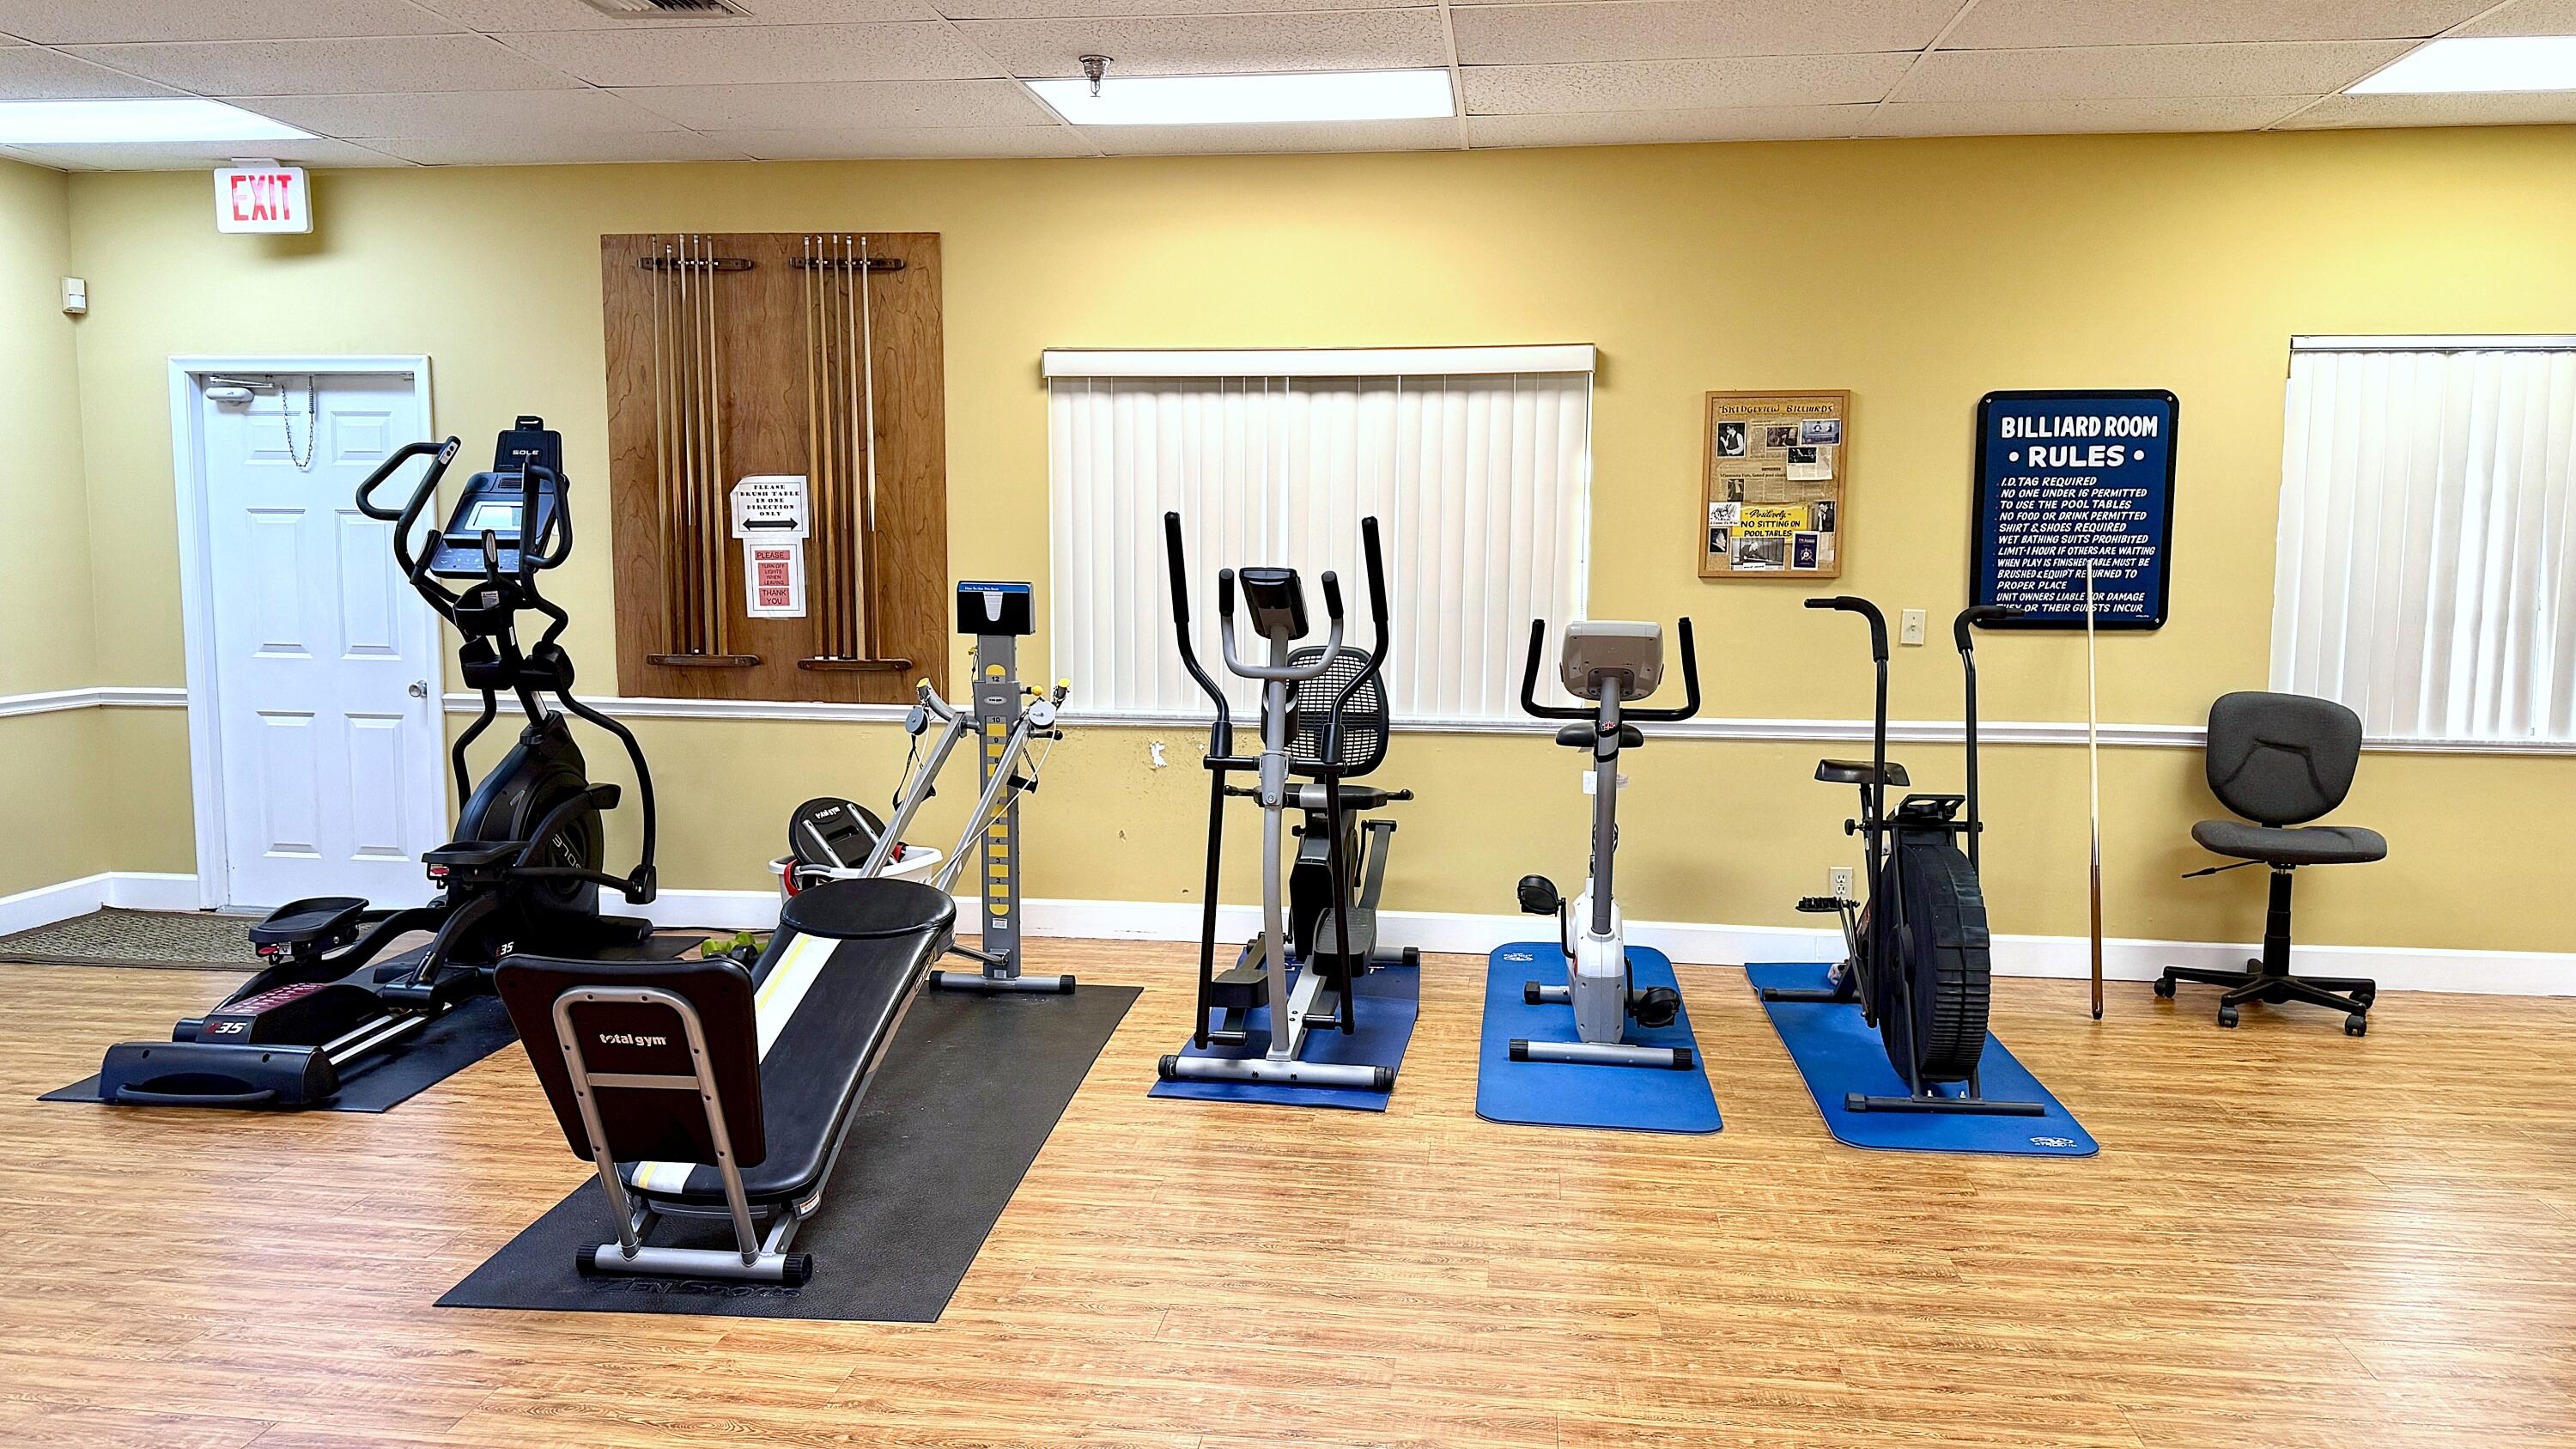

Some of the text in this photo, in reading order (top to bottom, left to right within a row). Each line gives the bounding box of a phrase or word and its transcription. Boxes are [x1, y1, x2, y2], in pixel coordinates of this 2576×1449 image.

[231, 175, 292, 221] EXIT
[2002, 416, 2158, 438] BILLIARD ROOM
[2028, 445, 2125, 467] RULES
[2001, 477, 2097, 487] I.D. TAG REQUIRED
[2001, 489, 2148, 498] NO ONE UNDER 16 PERMITTED
[2001, 500, 2132, 509] TO USE THE POOL TABLES
[1999, 511, 2147, 521] NO FOOD OR DRINK PERMITTED
[1999, 523, 2030, 533] SHIRT
[2075, 523, 2127, 533] REQUIRED
[1999, 534, 2148, 544] WET BATHING SUITS PROHIBITED
[2032, 546, 2057, 556] HOUR
[2057, 546, 2066, 556] IF
[2067, 546, 2099, 556] OTHERS
[2099, 546, 2117, 556] ARE
[2119, 546, 2155, 556] WAITING
[1998, 558, 2020, 567] WHEN
[2022, 558, 2043, 567] PLAY
[2044, 558, 2052, 567] IS
[2053, 558, 2087, 567] FINISHED
[2111, 558, 2136, 567] MUST
[2138, 558, 2151, 567] BE
[2075, 569, 2122, 579] REURNED
[2125, 569, 2138, 579] TO
[1996, 581, 2068, 590] PROPER PLACE
[1996, 593, 2145, 601] UNIT OWNERS LIABLE OR DAMAGE
[2025, 604, 2038, 612] OR
[2042, 604, 2071, 612] THEIR
[2113, 604, 2143, 612] INCUR
[599, 1033, 666, 1047] total gym
